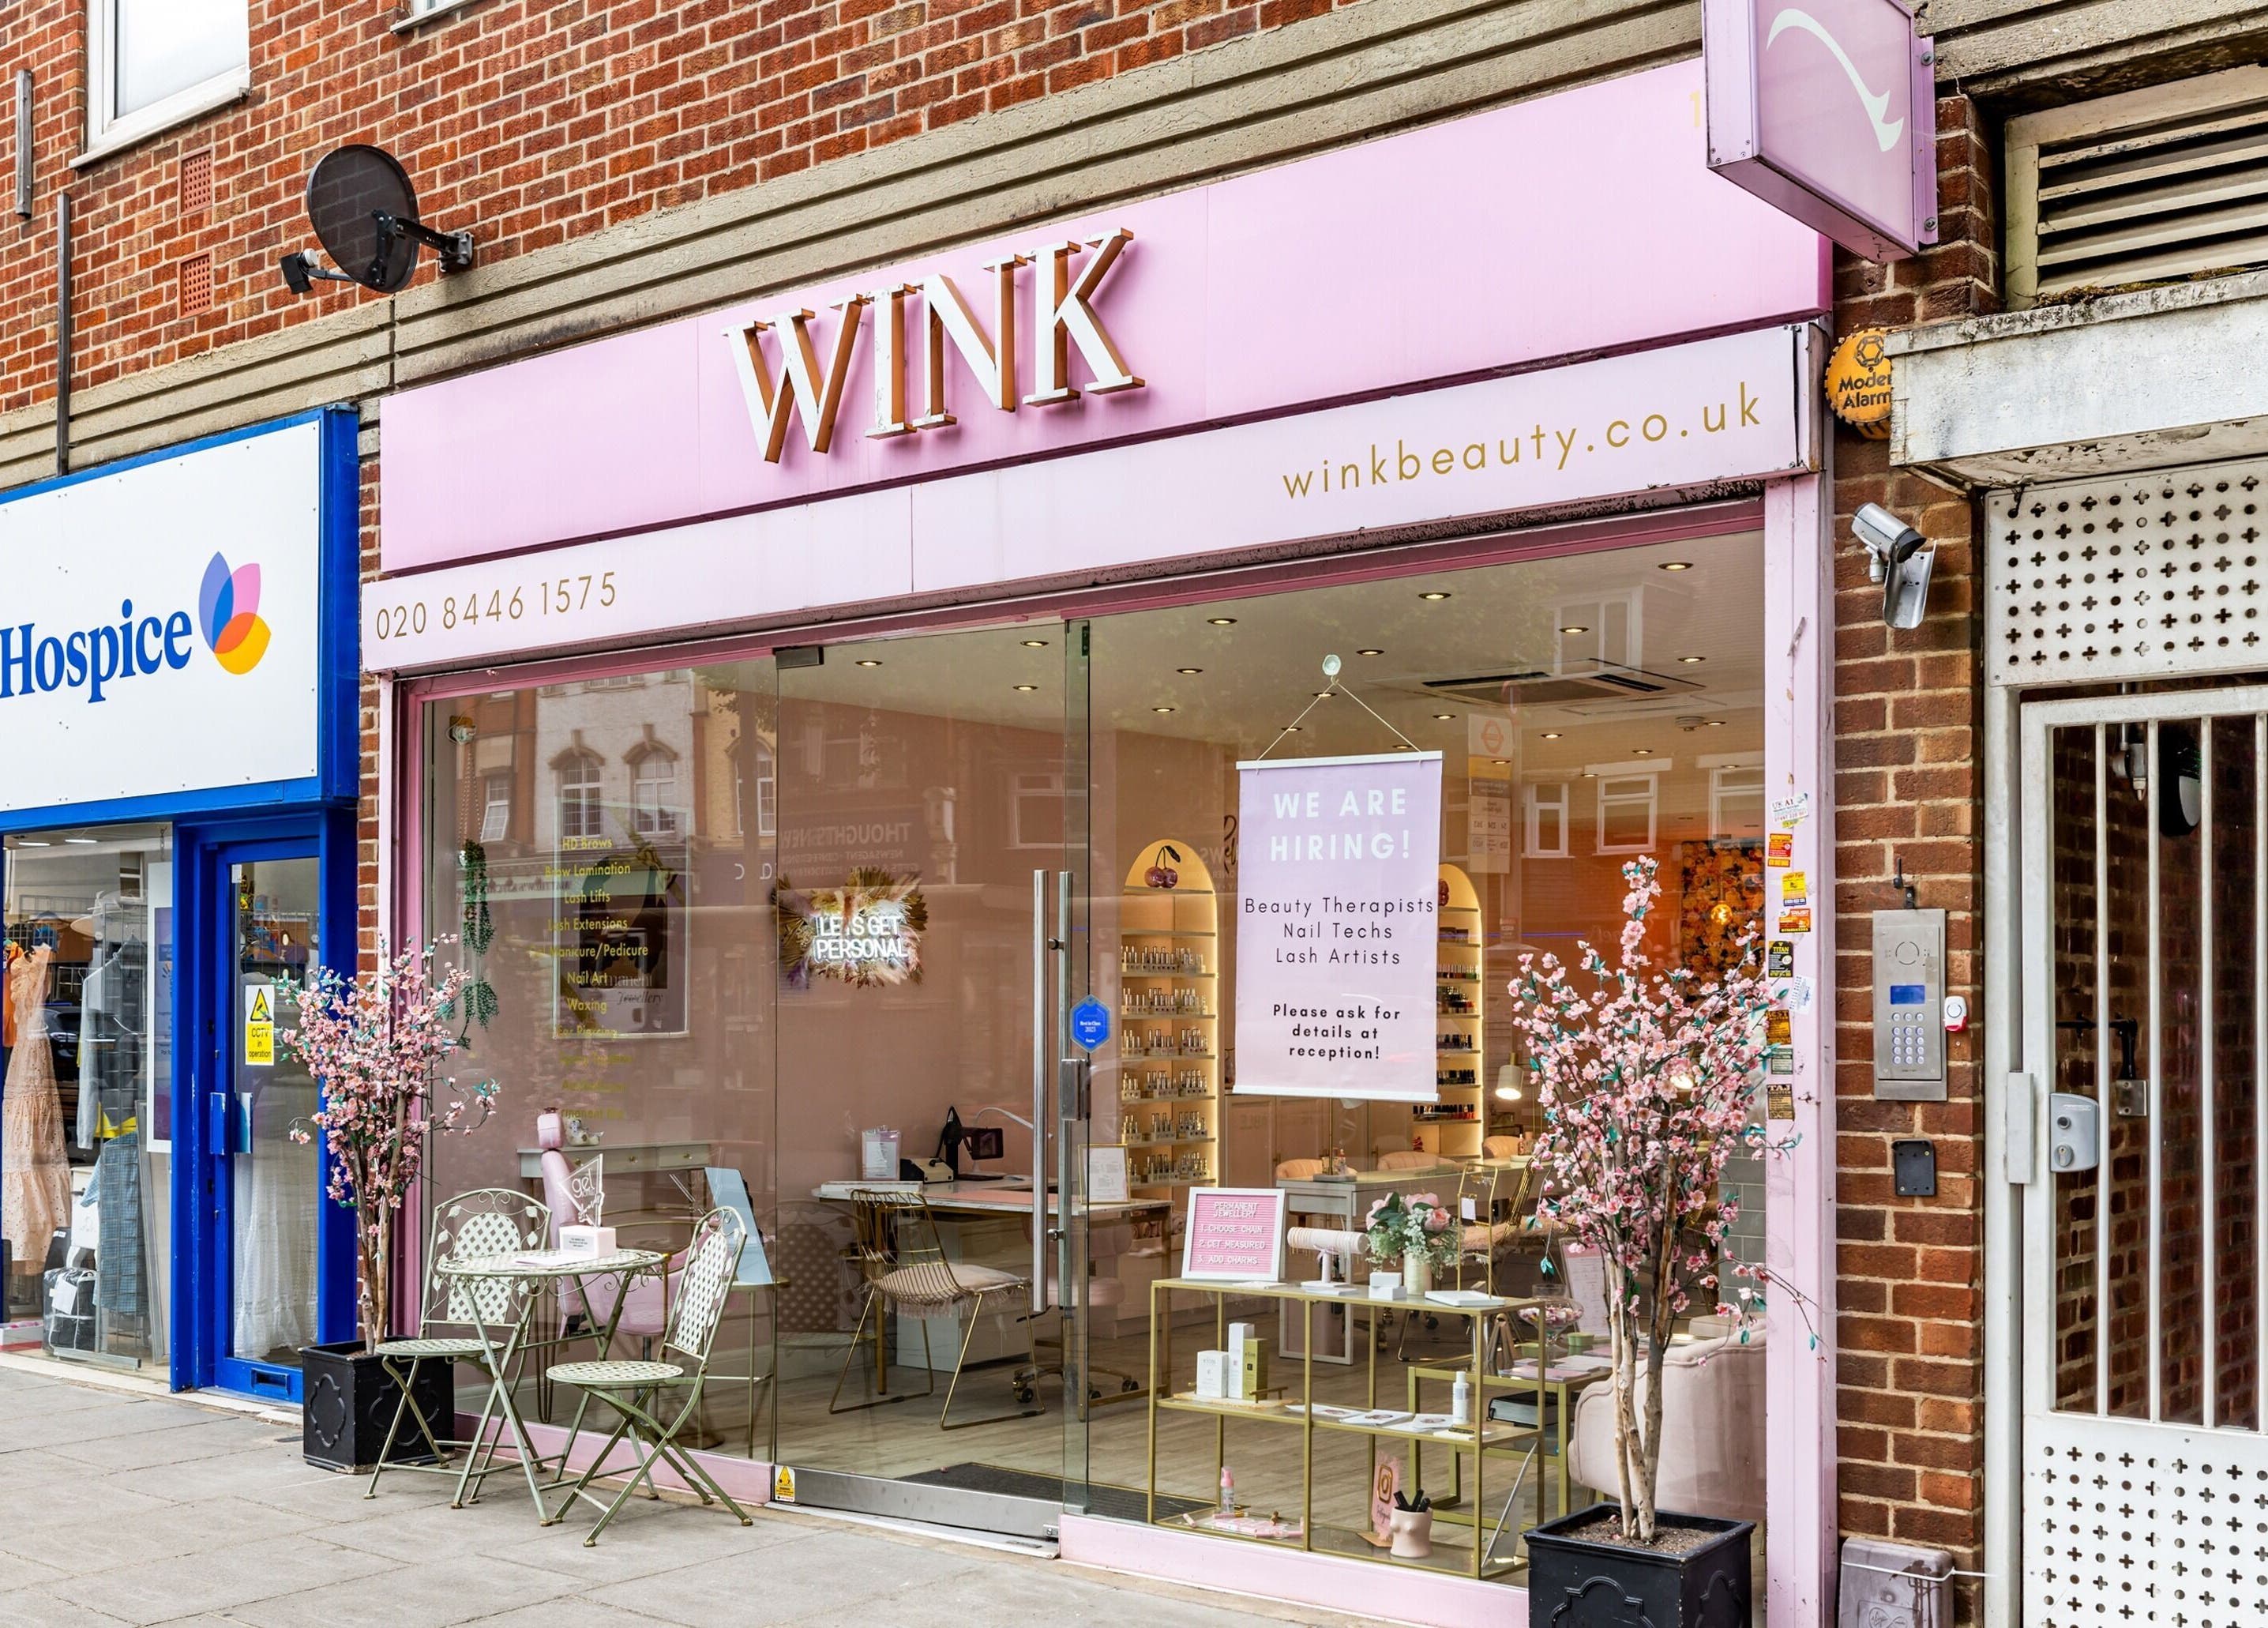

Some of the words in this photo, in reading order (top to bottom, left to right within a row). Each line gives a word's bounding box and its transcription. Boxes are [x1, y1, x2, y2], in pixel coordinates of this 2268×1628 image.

[720, 227, 1146, 464] WINK
[1838, 372, 1891, 393] Moder
[1282, 381, 1761, 500] winkbeauty.co.uk
[377, 602, 426, 640] 020
[443, 586, 524, 630] 8446
[541, 571, 616, 615] 1575
[0, 598, 192, 703] Hospice
[1273, 791, 1320, 819] WE
[1339, 786, 1408, 818] ARE
[562, 838, 577, 850] HD
[580, 837, 613, 850] Brows
[1270, 829, 1411, 863] HIRING!
[573, 862, 631, 876] Lamination
[564, 891, 587, 904] Lash
[590, 888, 610, 903] Lifts
[1245, 897, 1312, 918] Beauty
[1322, 896, 1434, 918] Therapists
[573, 917, 629, 931] Extensions
[867, 916, 900, 936] GET
[1283, 921, 1321, 938] Nail
[1332, 921, 1393, 938] Techs
[814, 938, 910, 961] PERSONAL
[1275, 946, 1317, 964] Lash
[1328, 947, 1401, 964] Artists
[566, 971, 589, 985] Nail
[591, 972, 608, 984] Art
[566, 998, 607, 1015] Waxing
[1273, 1003, 1327, 1018] Please
[1336, 1005, 1365, 1019] ask
[1375, 1006, 1401, 1019] for
[251, 1028, 269, 1038] CCTV
[1292, 1023, 1352, 1039] details
[1361, 1027, 1379, 1040] at
[249, 1050, 272, 1059] operation
[1289, 1045, 1380, 1062] reception!
[572, 1168, 595, 1198] gel
[1213, 1201, 1259, 1211] PERMANENT
[1212, 1210, 1257, 1220] JEWELLERY
[1241, 1225, 1264, 1235] CHAIN
[1225, 1239, 1266, 1250] MEASURED
[1207, 1254, 1224, 1265] ADD
[1226, 1255, 1259, 1265] CHARMS
